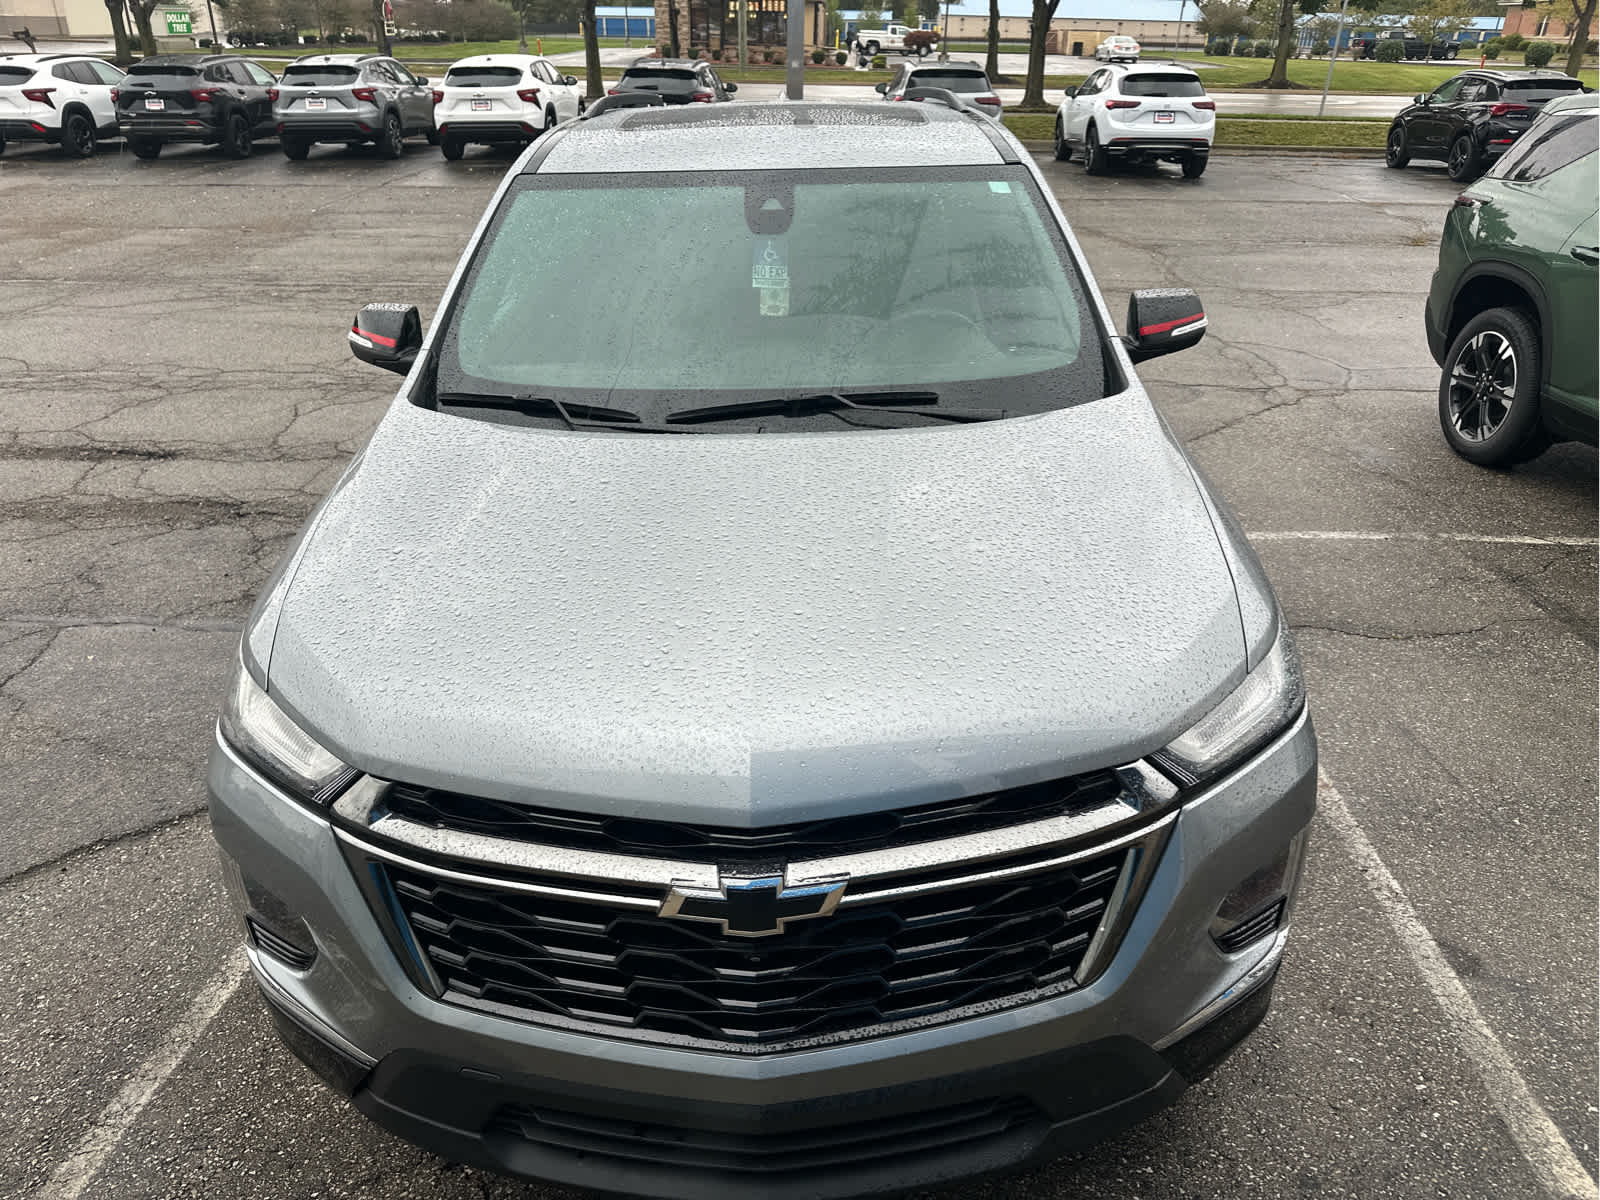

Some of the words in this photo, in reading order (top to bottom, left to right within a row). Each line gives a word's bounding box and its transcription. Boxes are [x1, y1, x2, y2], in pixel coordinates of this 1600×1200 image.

[166, 13, 190, 23] DOLLAR
[172, 23, 188, 33] TREE
[752, 264, 767, 278] NO
